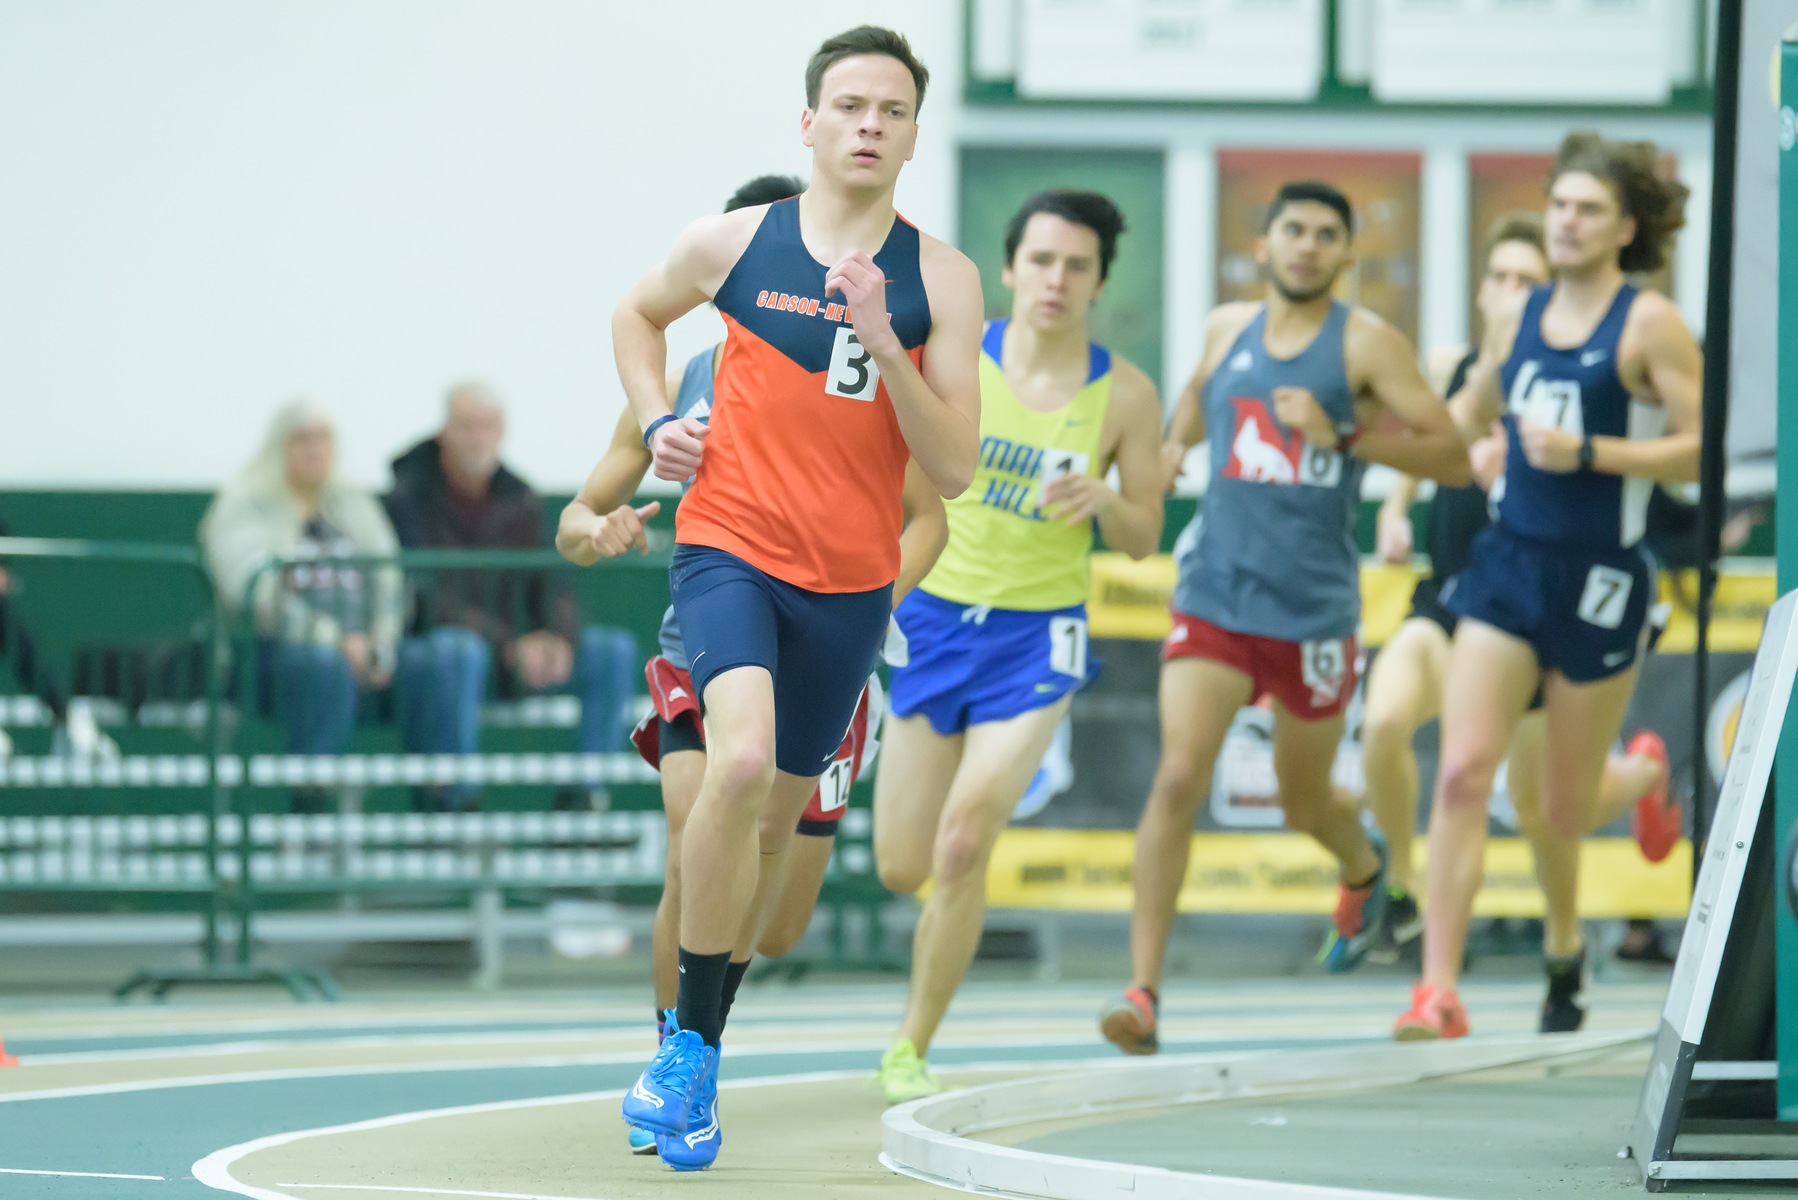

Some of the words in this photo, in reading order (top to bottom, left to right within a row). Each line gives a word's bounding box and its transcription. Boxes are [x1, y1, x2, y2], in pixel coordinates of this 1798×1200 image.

[756, 289, 892, 324] CARSON-NE
[836, 333, 873, 395] 3
[1551, 391, 1570, 428] 7
[981, 436, 1046, 480] MA
[1594, 577, 1620, 618] 7
[1065, 625, 1077, 669] 1
[1312, 641, 1335, 680] 6
[830, 760, 851, 805] 12
